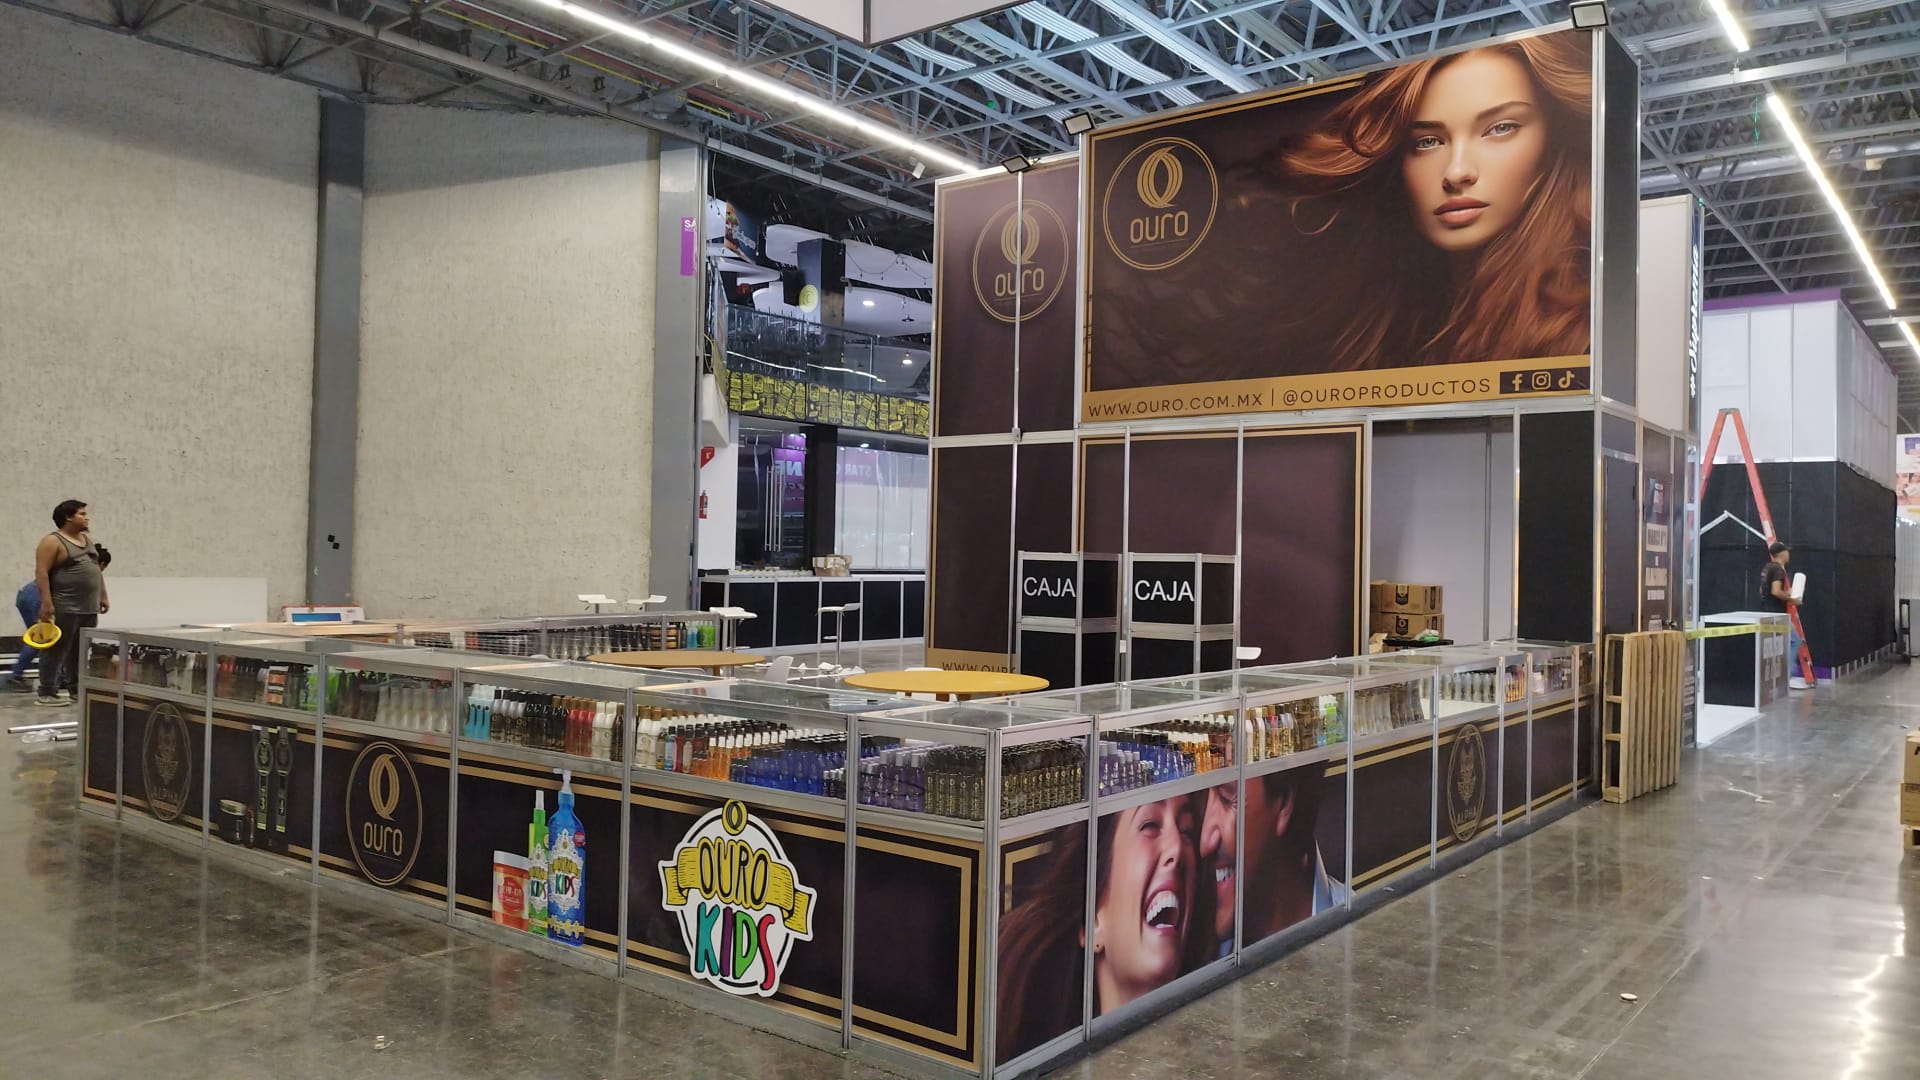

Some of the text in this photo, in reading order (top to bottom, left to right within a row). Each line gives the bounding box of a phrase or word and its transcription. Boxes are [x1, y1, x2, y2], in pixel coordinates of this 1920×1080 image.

[1088, 378, 1491, 417] WWW.OURO.COM.MX @OUROPRODUCTOS
[1023, 576, 1076, 598] CAJA
[1134, 579, 1195, 602] CAJA
[700, 841, 769, 905] OURO
[695, 902, 776, 991] KIDS
